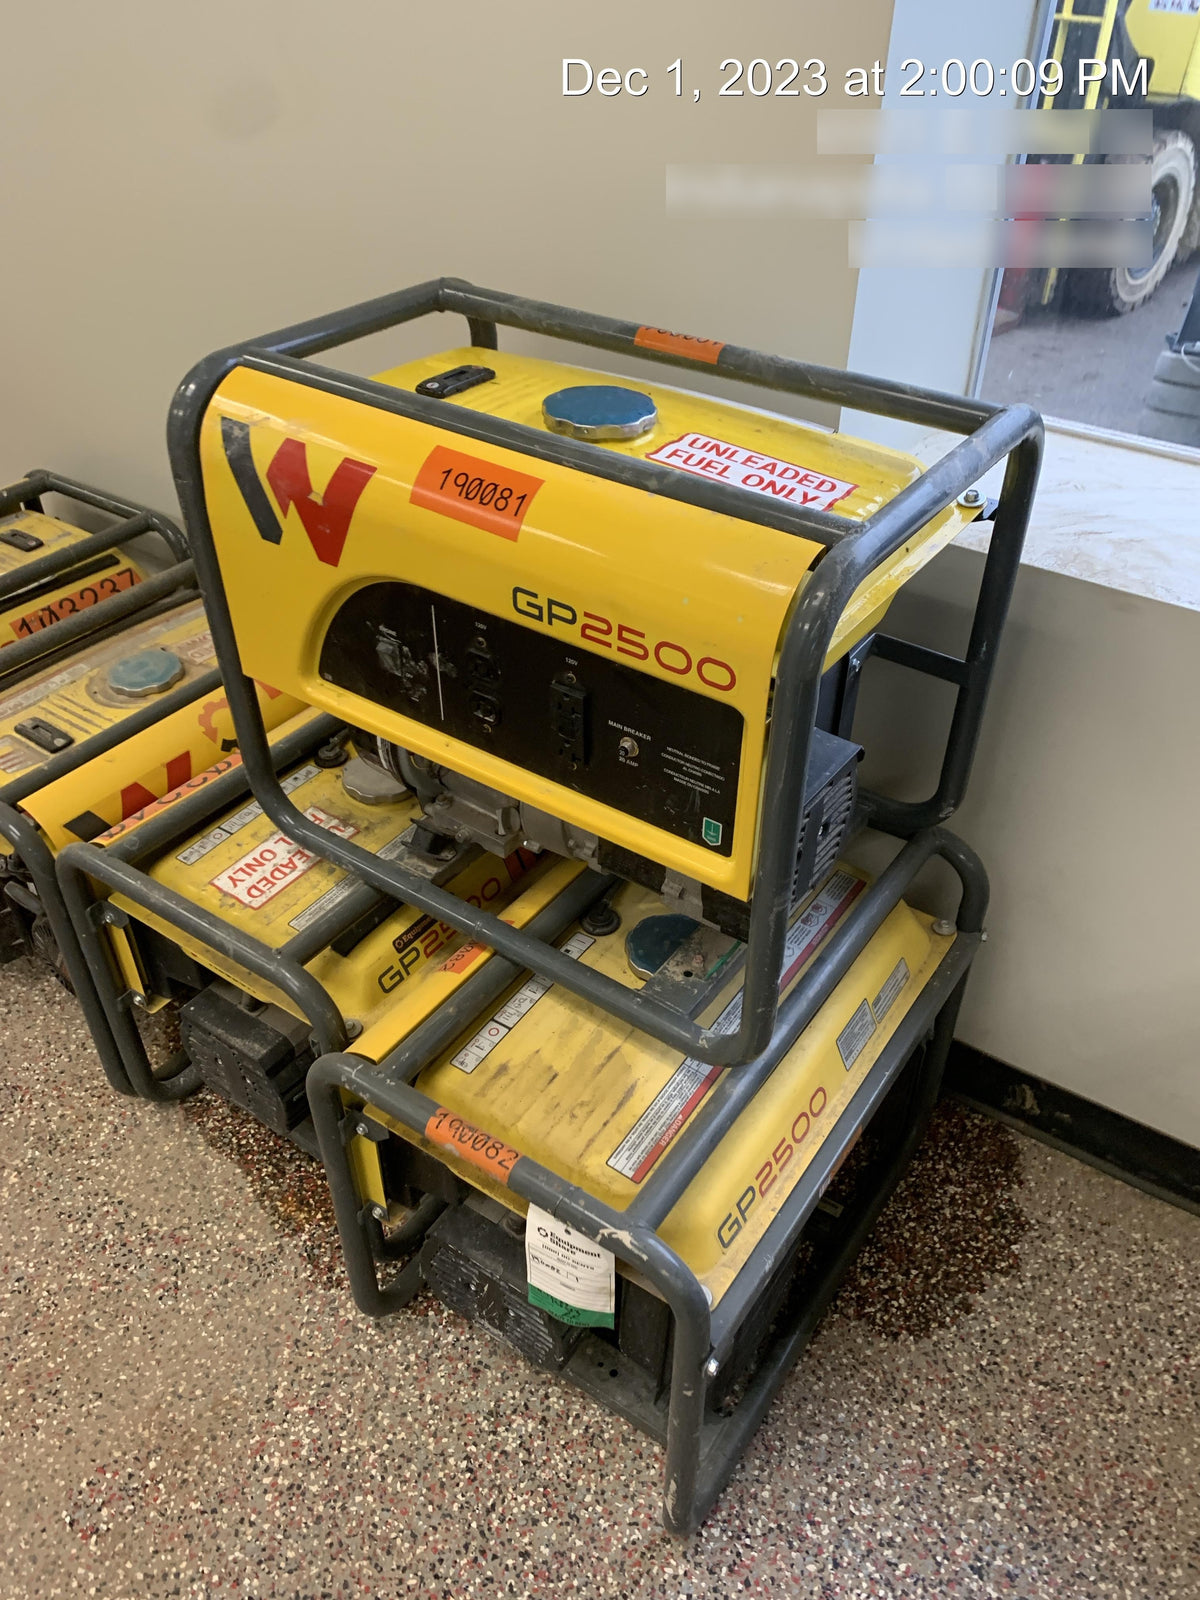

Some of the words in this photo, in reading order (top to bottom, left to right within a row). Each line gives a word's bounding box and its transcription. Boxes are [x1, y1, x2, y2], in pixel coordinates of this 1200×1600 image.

[665, 448, 731, 480] FUEL
[741, 473, 823, 507] ONLY
[688, 436, 837, 494] UNLEADED
[440, 468, 527, 517] 190081
[512, 586, 737, 692] GP2500
[608, 719, 623, 730] MAIN
[623, 725, 652, 741] BREAKER
[227, 848, 278, 889] ONLY
[659, 1118, 683, 1147] DANGER
[717, 1086, 827, 1249] GP2500
[551, 1232, 601, 1258] Equipment
